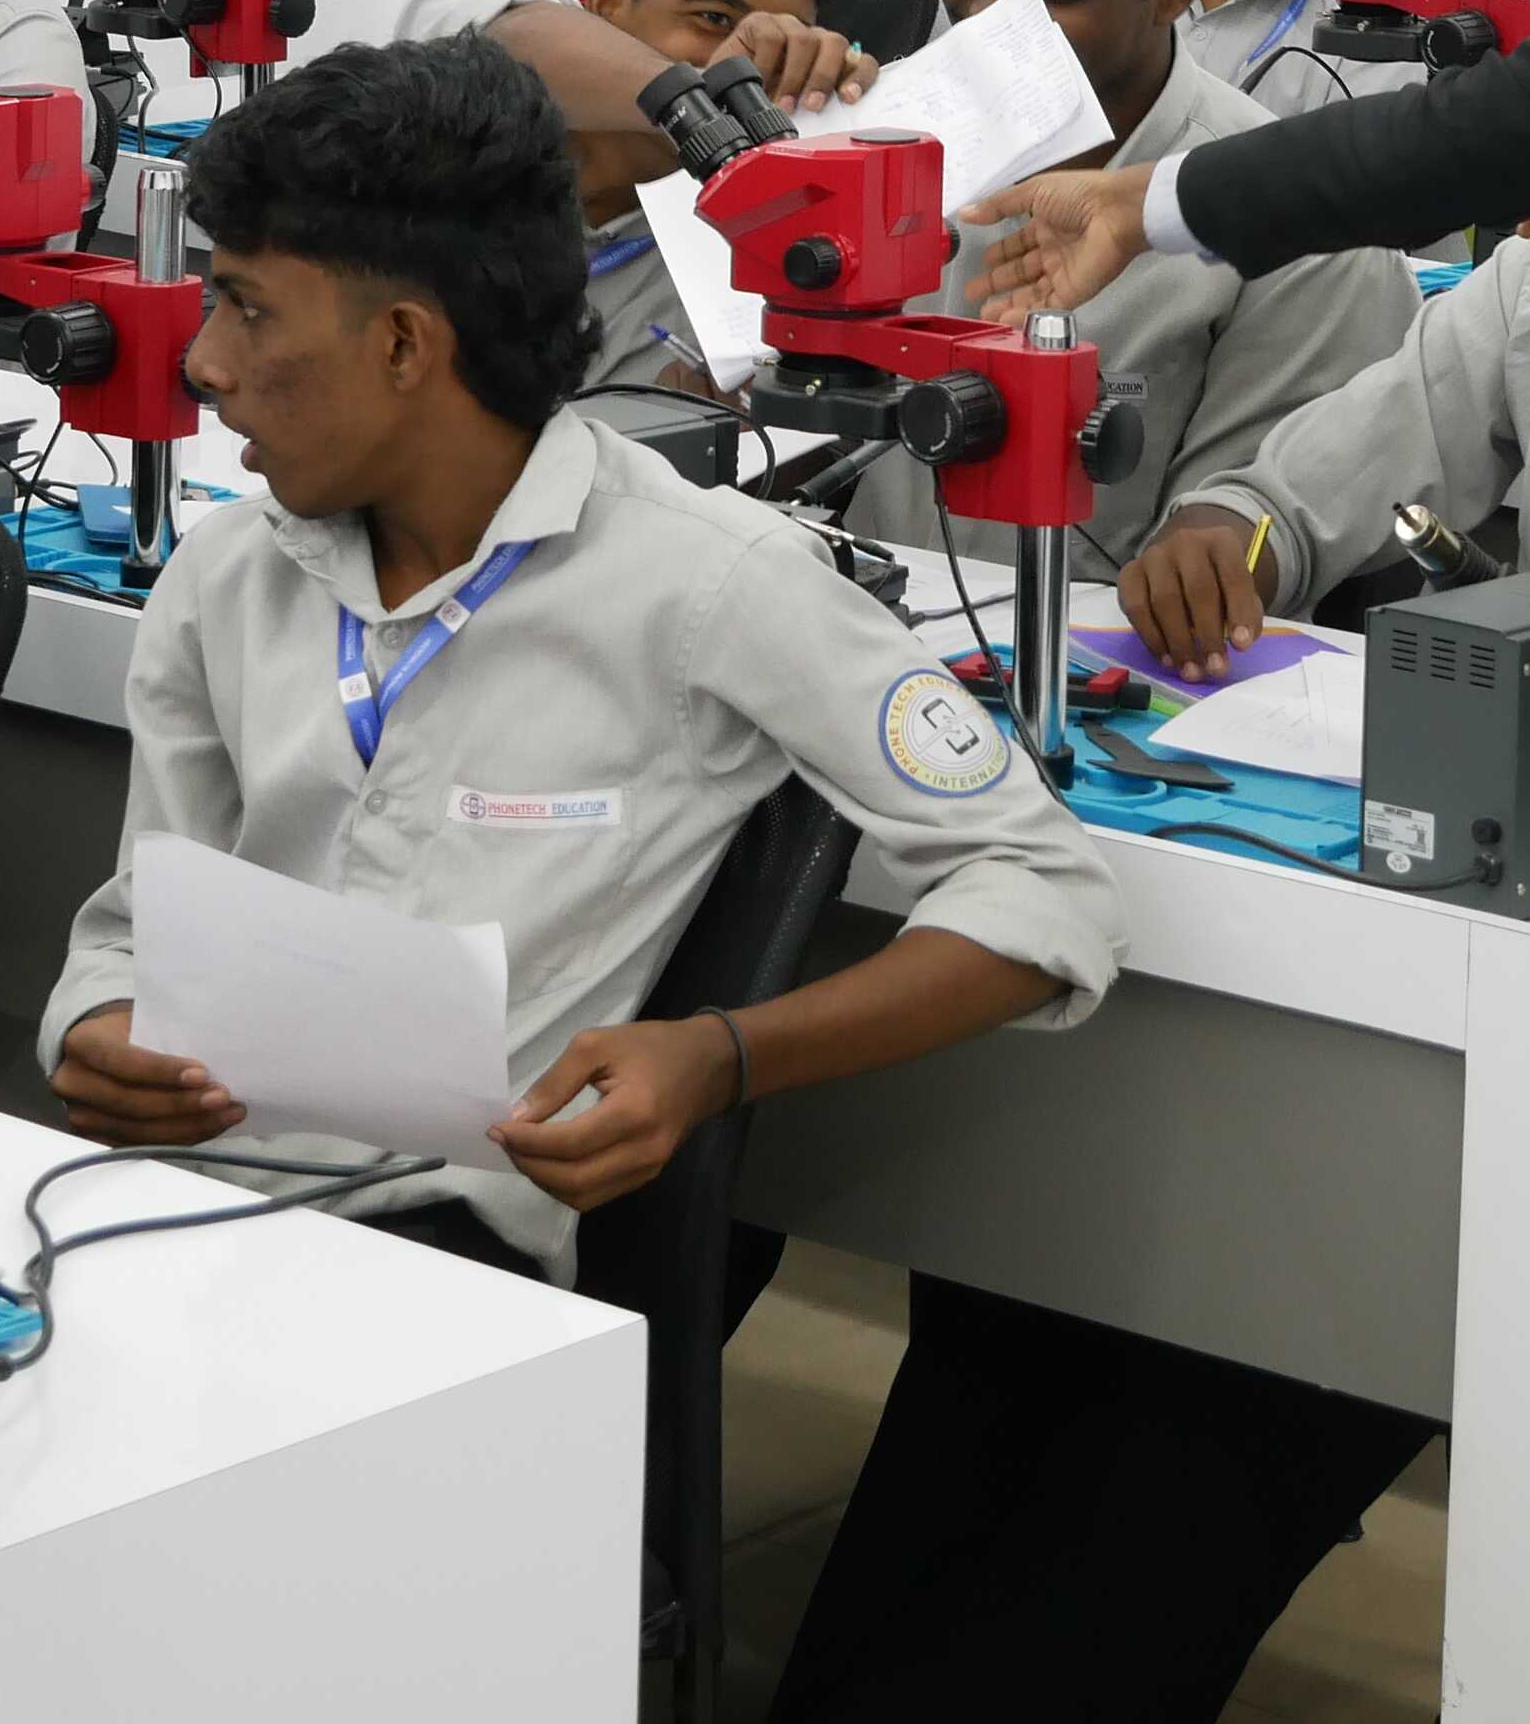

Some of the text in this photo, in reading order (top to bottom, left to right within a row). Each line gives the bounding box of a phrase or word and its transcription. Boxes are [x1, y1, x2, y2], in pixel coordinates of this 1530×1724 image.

[891, 683, 916, 723] TECH
[890, 727, 919, 775] PHONE
[488, 800, 607, 815] PHONETECH EDUCATION
